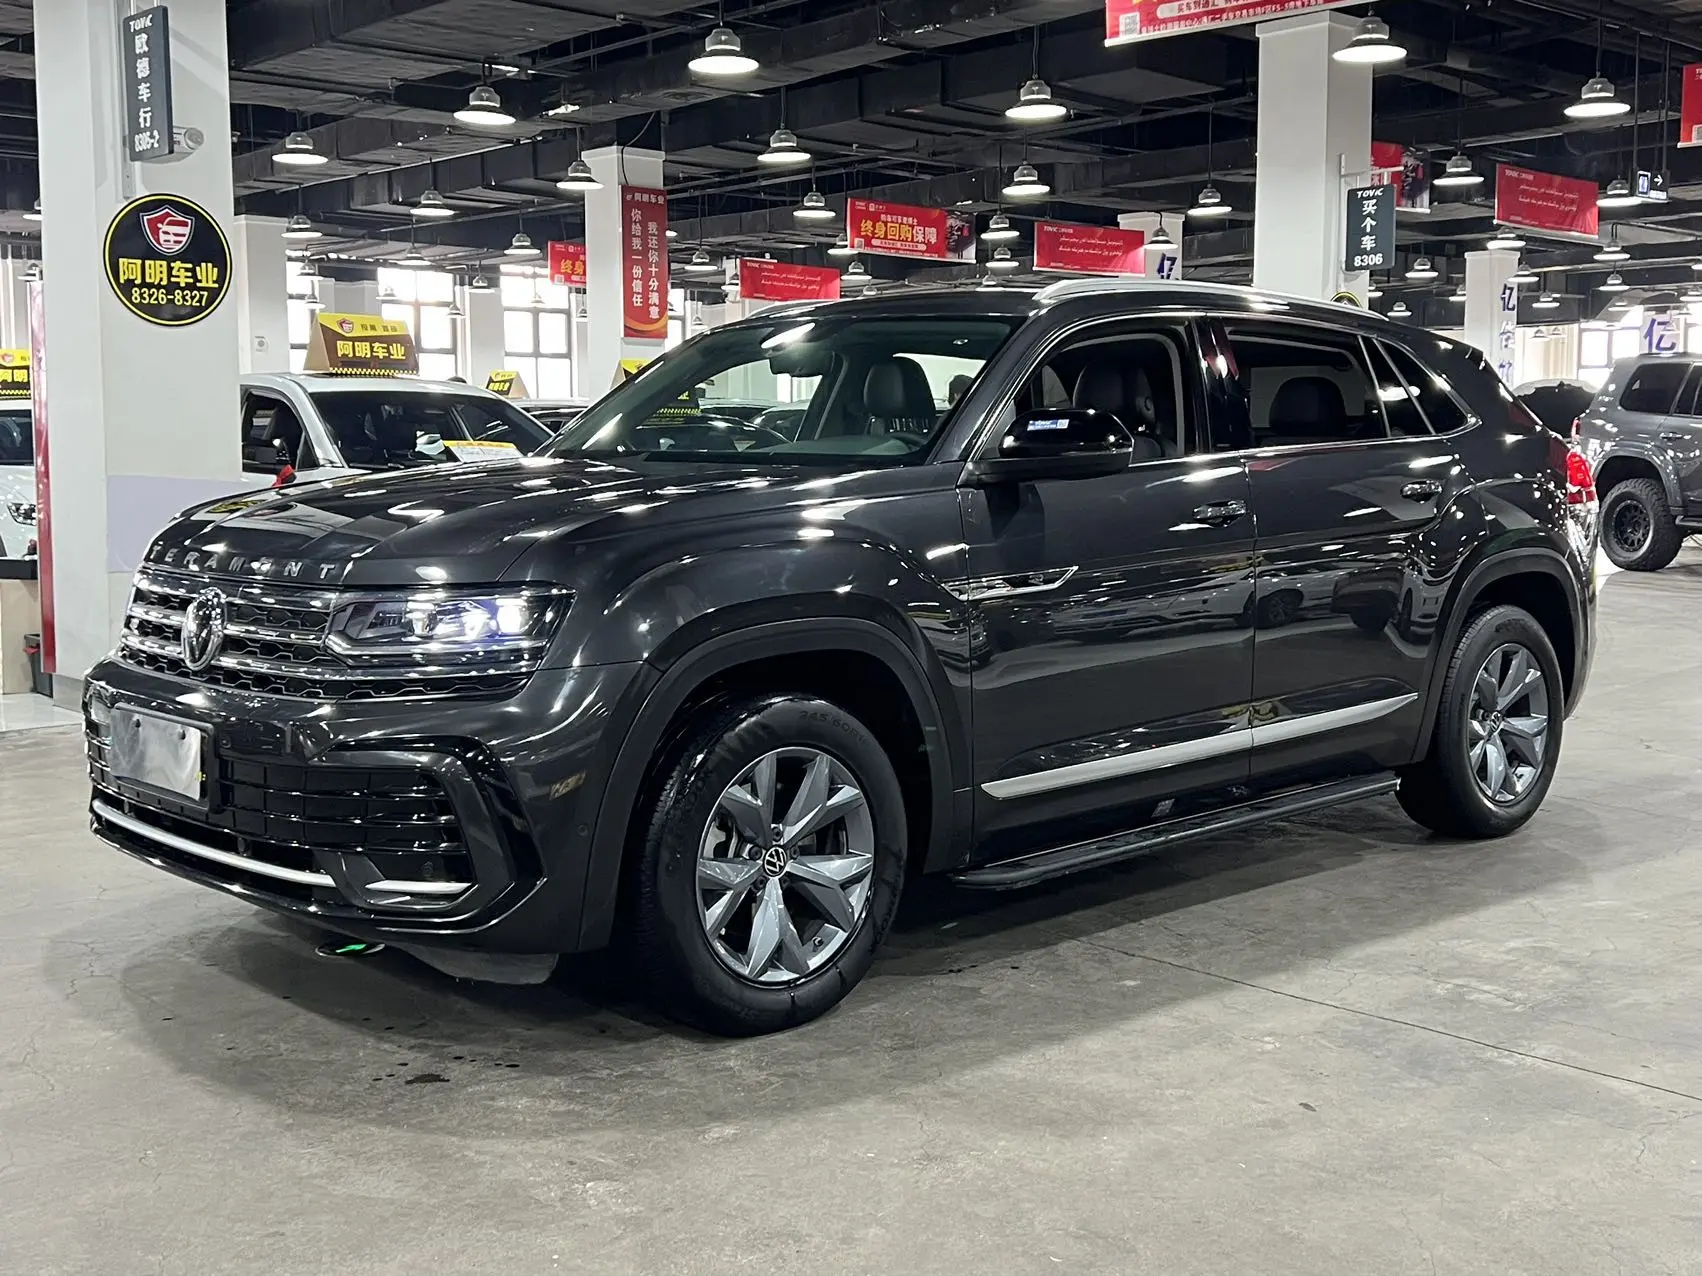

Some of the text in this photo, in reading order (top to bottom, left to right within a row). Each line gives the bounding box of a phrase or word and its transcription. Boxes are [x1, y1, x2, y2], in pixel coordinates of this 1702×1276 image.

[1356, 188, 1384, 199] TOVIC
[860, 219, 937, 244] 终身回购保障
[1360, 199, 1377, 251] 买个车
[631, 208, 643, 307] 你给我一份信任
[647, 221, 660, 319] 我还你十分满意
[1353, 253, 1383, 267] 8306
[118, 258, 219, 288] 阿明车业
[131, 287, 208, 306] 8326-8327
[336, 340, 406, 360] 阿明车业
[149, 546, 335, 579] TERAMONT
